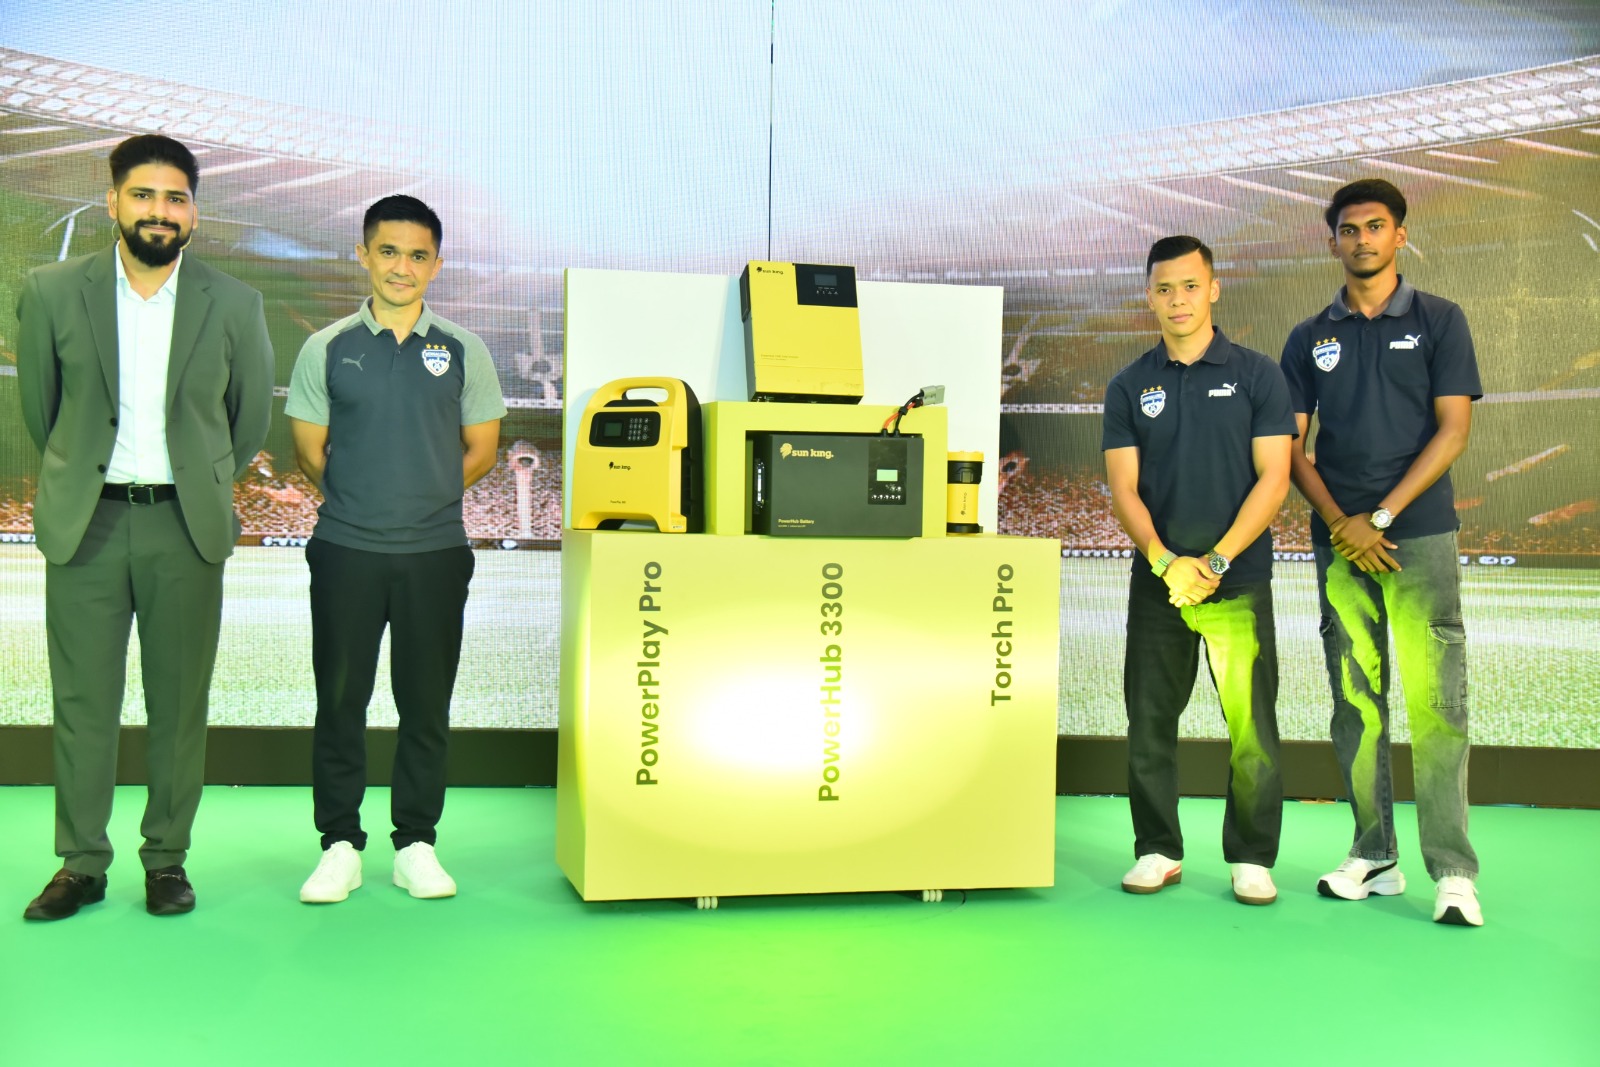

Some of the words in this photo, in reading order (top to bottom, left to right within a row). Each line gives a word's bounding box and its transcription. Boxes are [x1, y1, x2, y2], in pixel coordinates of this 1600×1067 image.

[1389, 340, 1415, 350] PUMA
[1208, 388, 1232, 397] PUMA
[792, 449, 809, 457] sun
[639, 561, 662, 612] Pro
[820, 562, 844, 637] 3300
[993, 563, 1014, 612] Pro
[991, 619, 1013, 707] Torch
[636, 619, 669, 786] PowerPlay
[818, 644, 843, 801] PowerHub
